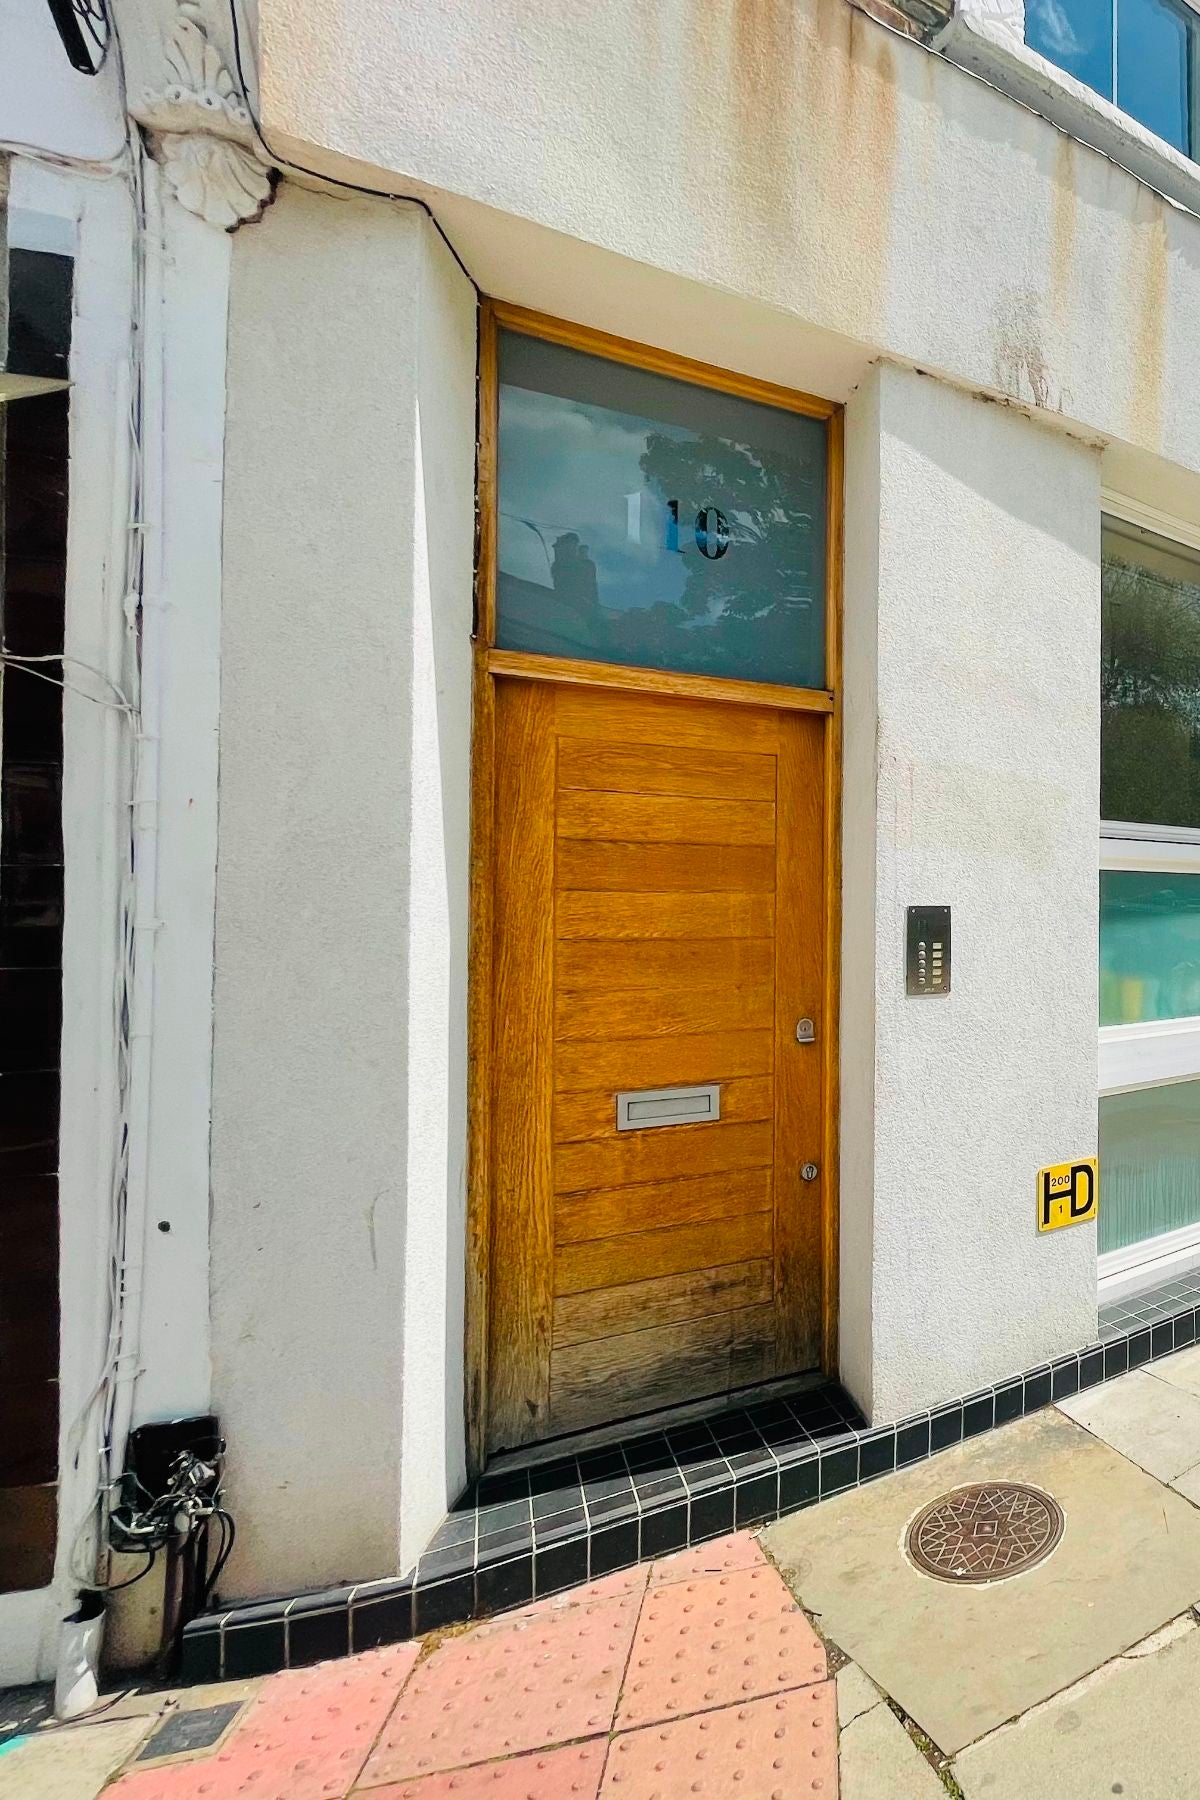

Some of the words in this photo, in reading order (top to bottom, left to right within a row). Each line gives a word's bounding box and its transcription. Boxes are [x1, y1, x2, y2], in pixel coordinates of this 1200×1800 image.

[1052, 1175, 1070, 1187] 200
[1044, 1164, 1094, 1224] HD
[1058, 1204, 1063, 1214] 1
